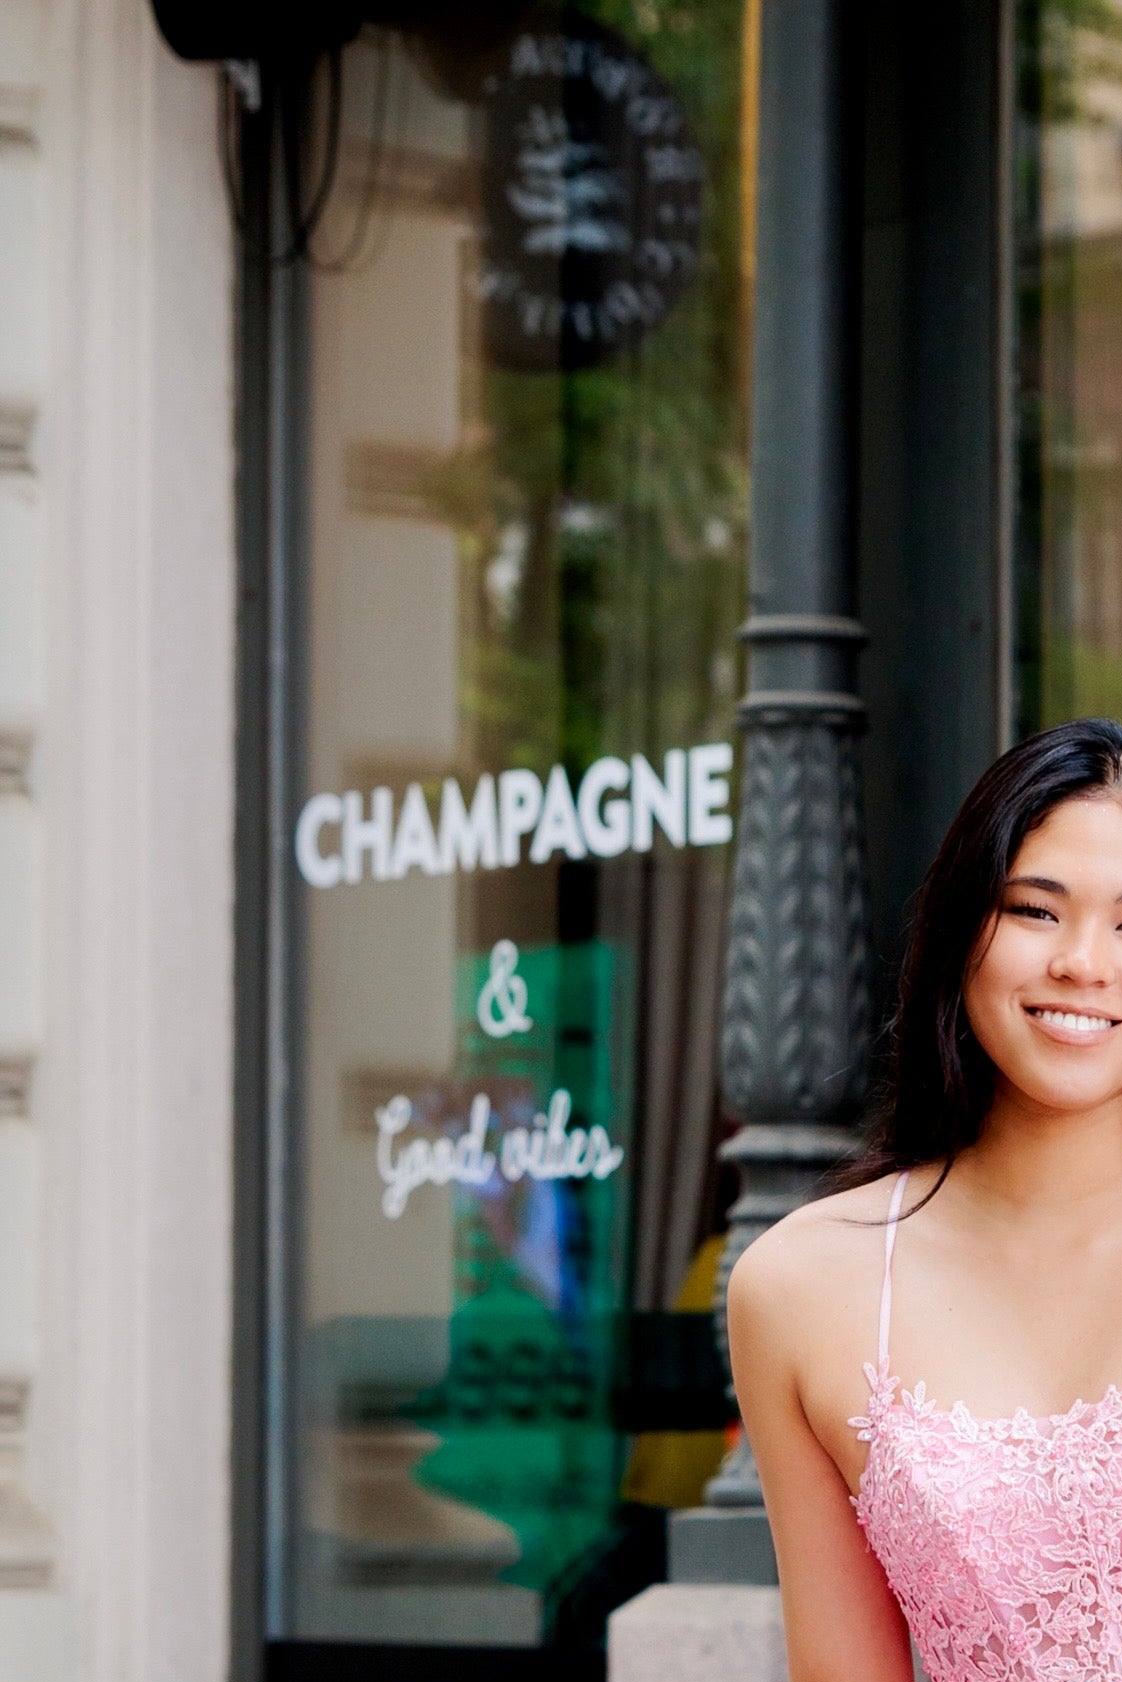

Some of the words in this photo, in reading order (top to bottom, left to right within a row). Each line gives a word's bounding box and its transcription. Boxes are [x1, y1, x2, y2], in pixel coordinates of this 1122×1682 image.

[295, 742, 734, 888] CHAMPAGNE
[477, 939, 532, 1037] &
[375, 1092, 496, 1220] Good
[502, 1088, 625, 1180] vibes
